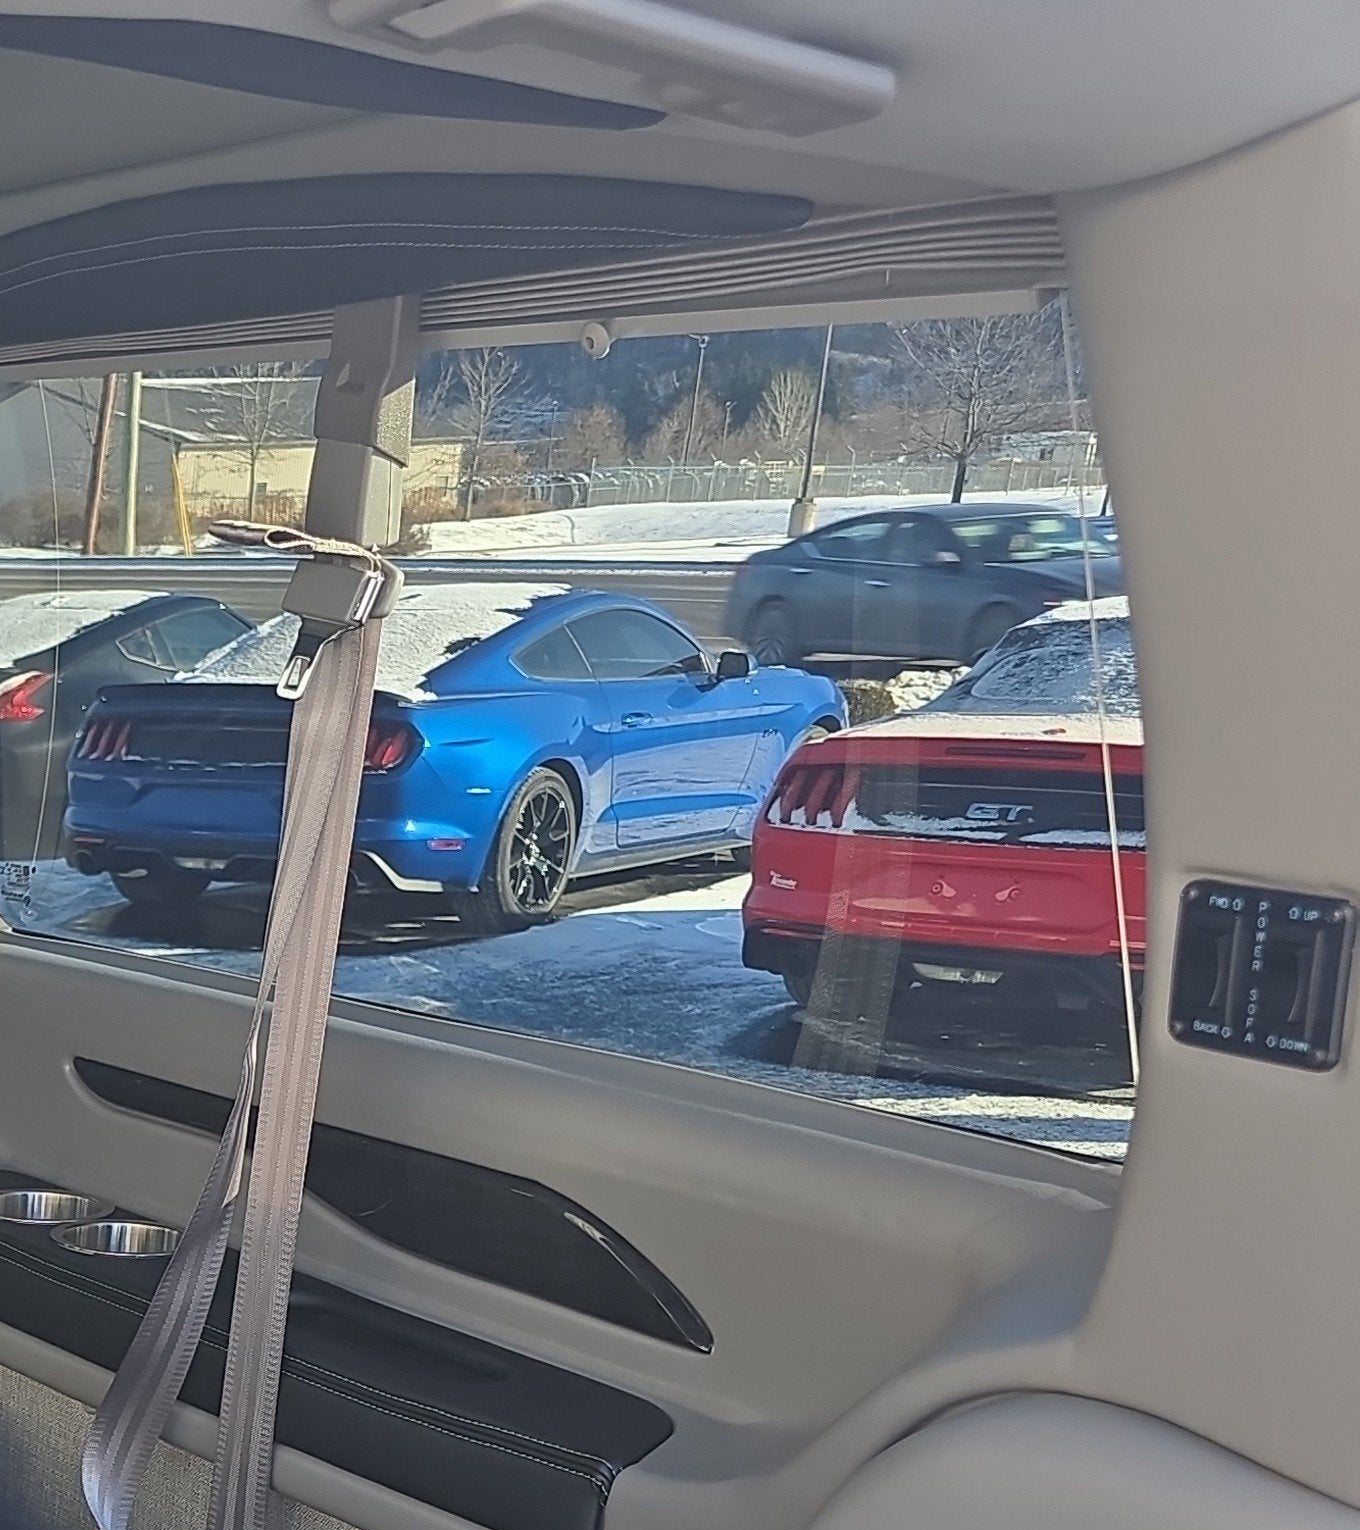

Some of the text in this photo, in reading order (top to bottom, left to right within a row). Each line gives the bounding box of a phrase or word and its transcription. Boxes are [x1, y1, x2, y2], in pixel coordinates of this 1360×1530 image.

[966, 803, 1034, 821] GT
[1208, 896, 1229, 909] FWD
[1303, 911, 1319, 921] UP
[1243, 901, 1268, 1043] POWER SOFA
[1192, 1020, 1219, 1034] BACK
[1279, 1038, 1309, 1052] DOWN
